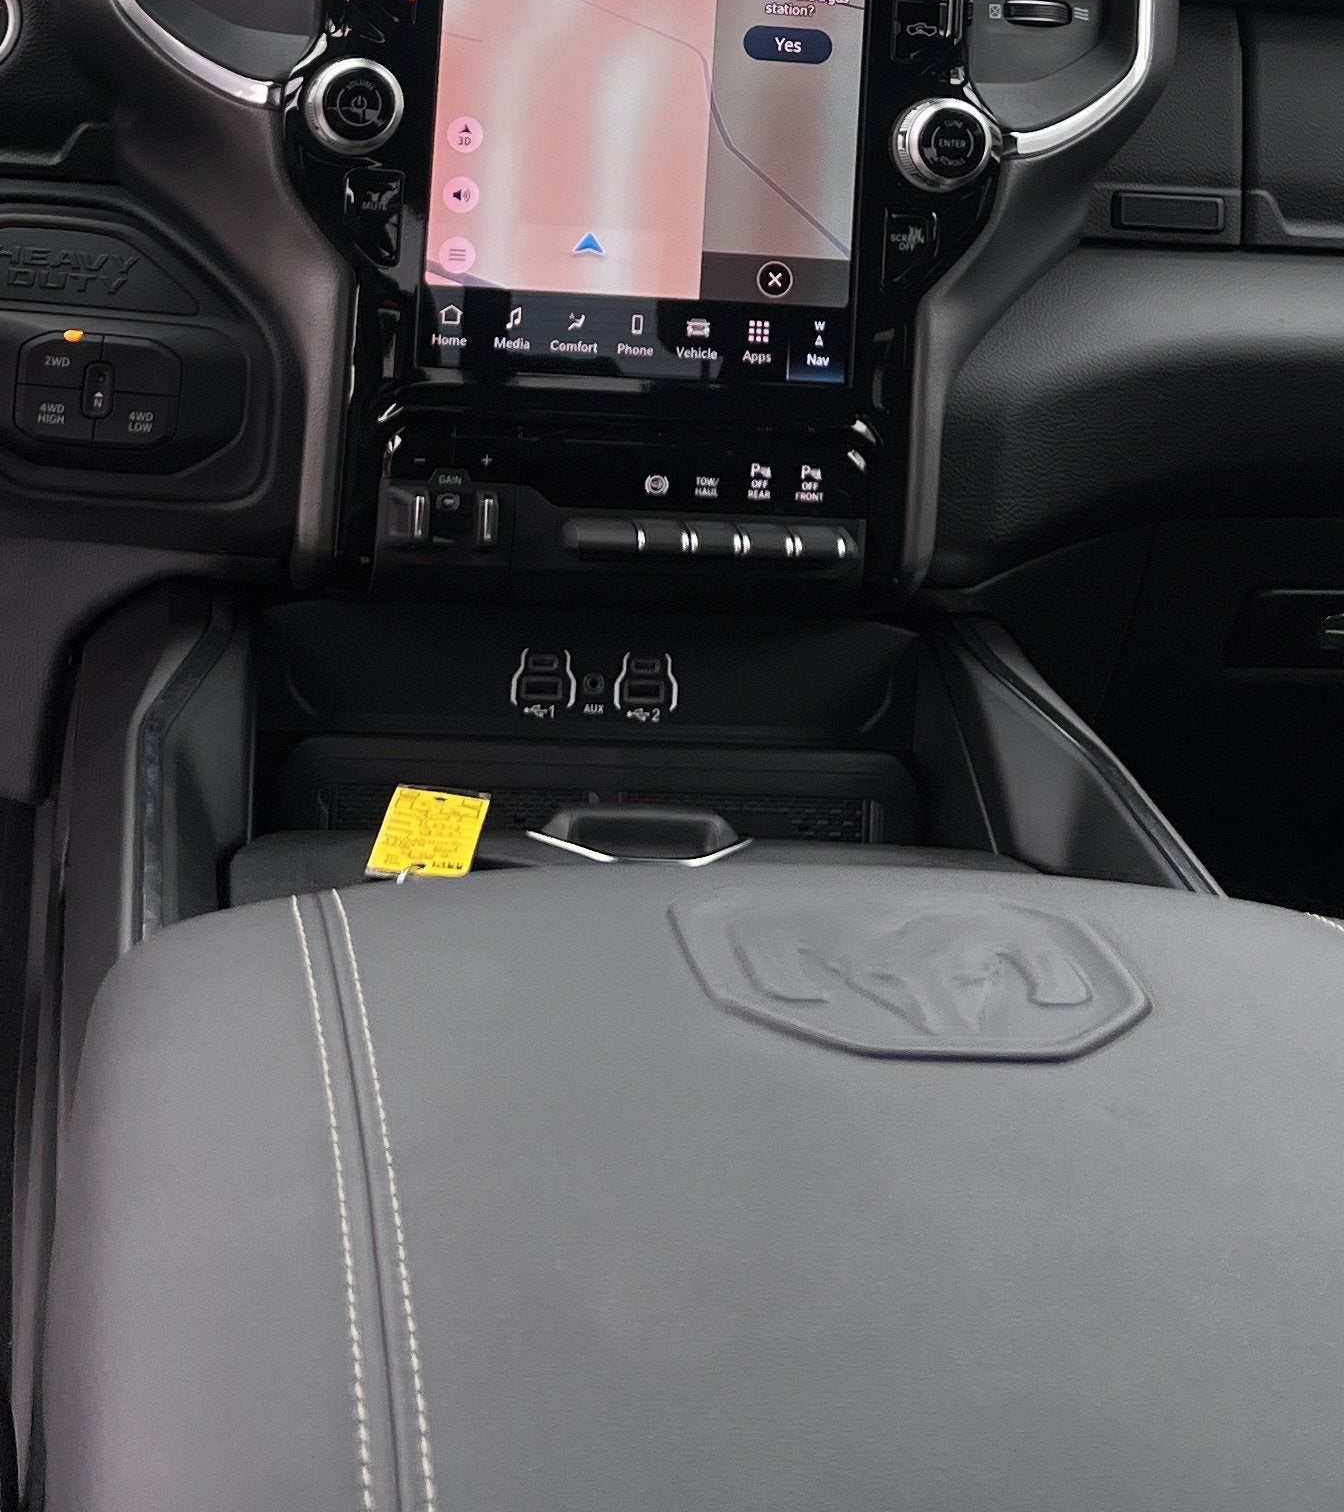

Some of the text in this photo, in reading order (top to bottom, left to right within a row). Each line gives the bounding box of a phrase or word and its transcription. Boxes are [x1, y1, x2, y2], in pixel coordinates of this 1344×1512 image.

[765, 3, 815, 16] station?
[774, 37, 801, 53] Yes
[347, 78, 376, 90] VOLUME
[458, 136, 471, 145] 3D
[938, 138, 966, 149] ENTER
[363, 201, 387, 211] MUTE
[7, 267, 128, 295] DUTY
[432, 334, 467, 346] Home
[494, 337, 530, 350] Media
[550, 340, 598, 353] Comfort
[617, 343, 654, 356] Phone
[676, 346, 718, 360] Vehicle
[742, 351, 772, 365] Apps
[45, 356, 70, 367] 2WD
[806, 354, 829, 367] Nav
[40, 403, 64, 413] 4WD
[93, 398, 103, 408] N
[38, 414, 65, 425] HIGH
[129, 411, 154, 422] 4WD
[128, 422, 153, 433] LOW
[438, 474, 462, 485] GAIN
[751, 479, 768, 489] OFF
[802, 481, 819, 491] OFF
[695, 487, 718, 498] HAUL
[747, 490, 771, 500] REAR
[795, 492, 824, 503] FRONT
[583, 703, 604, 714] AUX
[651, 708, 661, 721] 2
